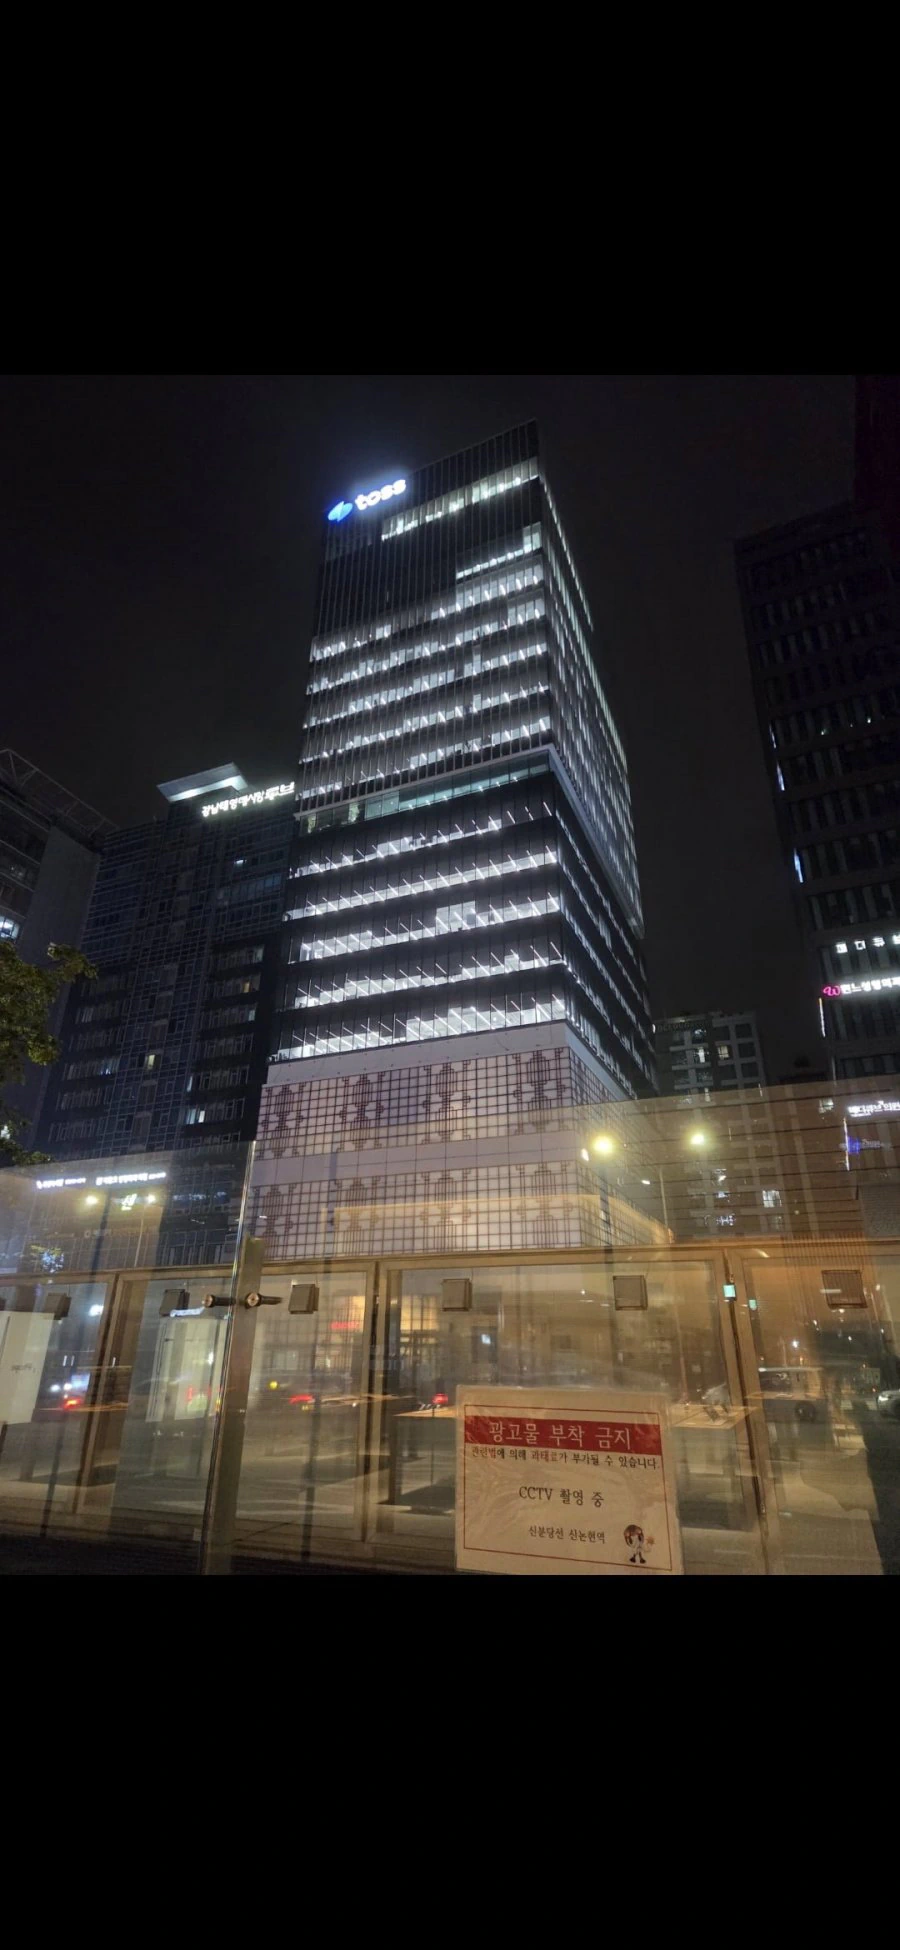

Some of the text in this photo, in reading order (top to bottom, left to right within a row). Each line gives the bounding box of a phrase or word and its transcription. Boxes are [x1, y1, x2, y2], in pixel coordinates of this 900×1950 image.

[355, 479, 406, 510] toss
[488, 1421, 631, 1451] 광고물 부착 금지
[472, 1446, 505, 1460] 관련법에
[509, 1448, 527, 1461] 의해
[531, 1450, 567, 1464] 과태료가
[604, 1455, 614, 1467] 수
[519, 1486, 604, 1508] CCTV 촬영 중
[529, 1525, 606, 1545] 신분당선 신논현역
